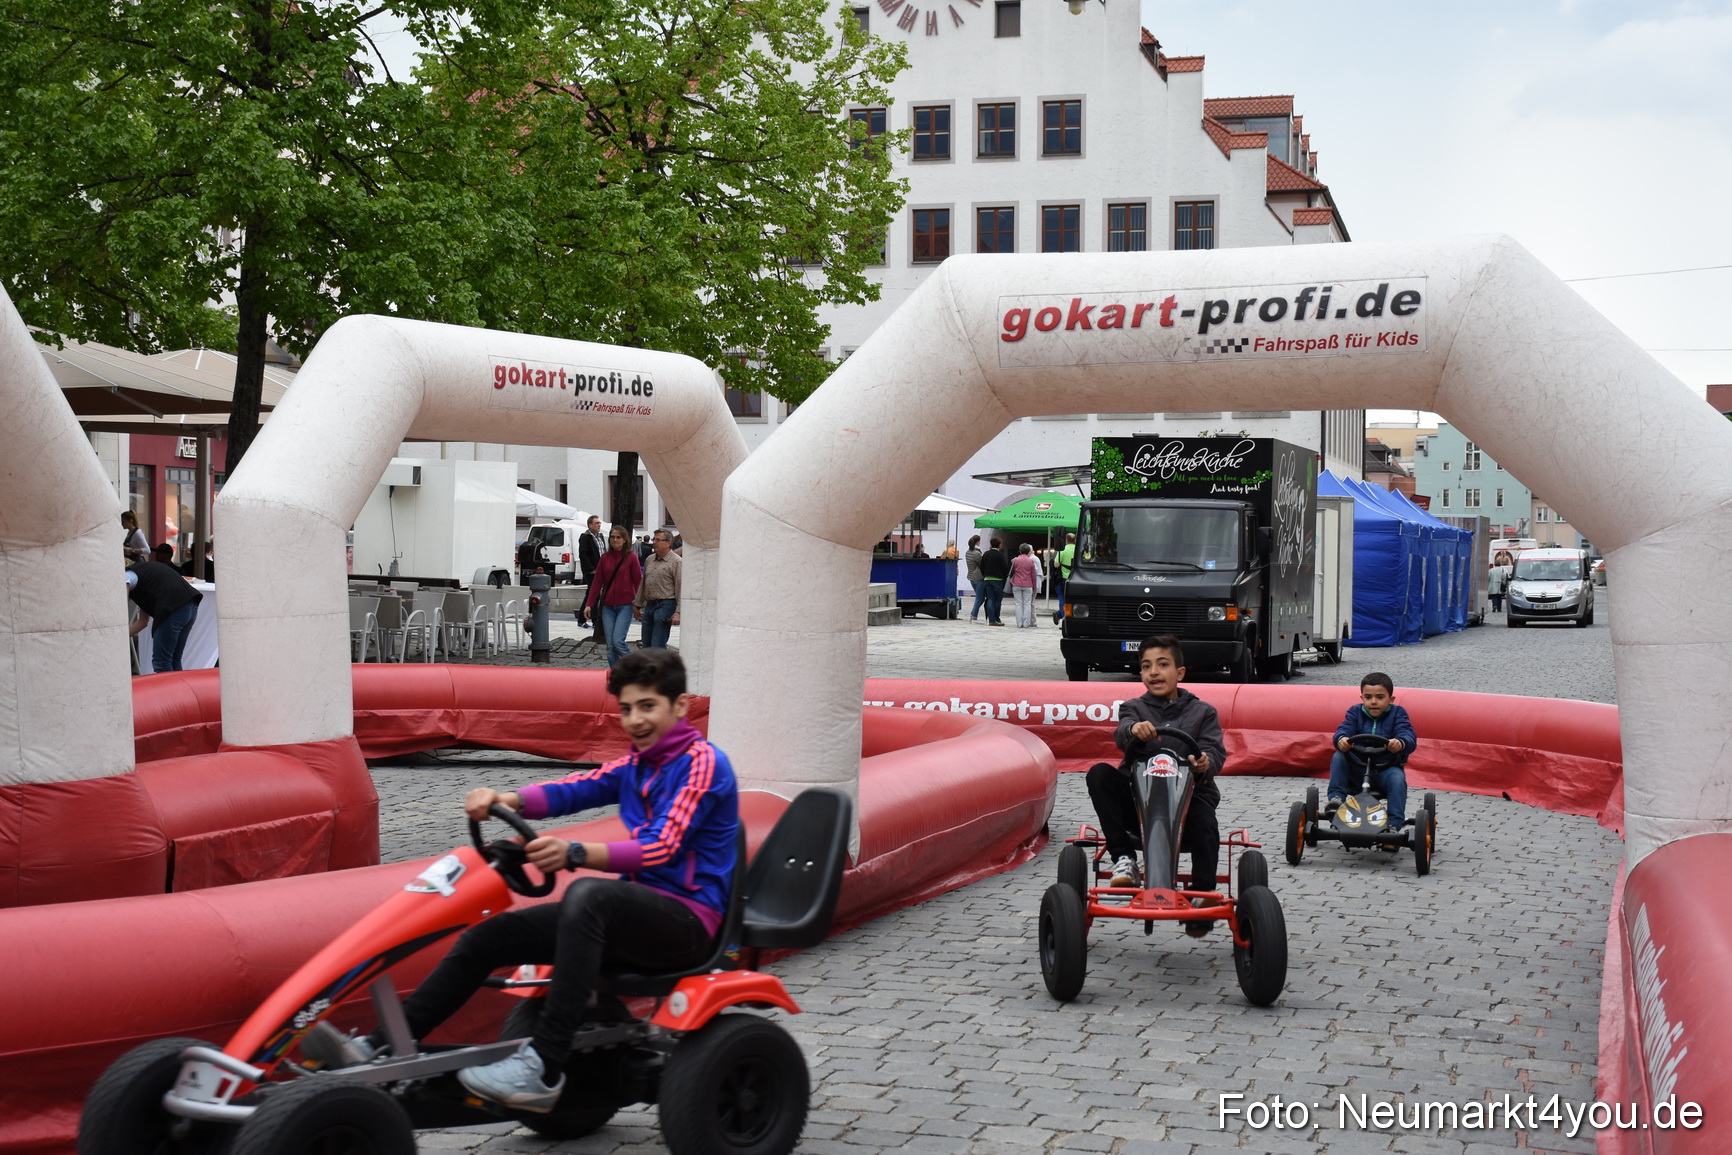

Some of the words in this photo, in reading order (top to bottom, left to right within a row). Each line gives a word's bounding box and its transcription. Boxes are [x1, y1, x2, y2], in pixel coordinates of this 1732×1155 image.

[1001, 282, 1421, 343] gokart-profi.de
[1253, 334, 1339, 353] Fahrspaß
[1345, 333, 1372, 348] für
[1376, 331, 1419, 347] Kids
[493, 362, 654, 397] gokart-profi.de
[592, 401, 625, 415] Fahrspaß
[625, 404, 636, 414] für
[636, 405, 652, 416] Kids
[1210, 483, 1226, 494] And
